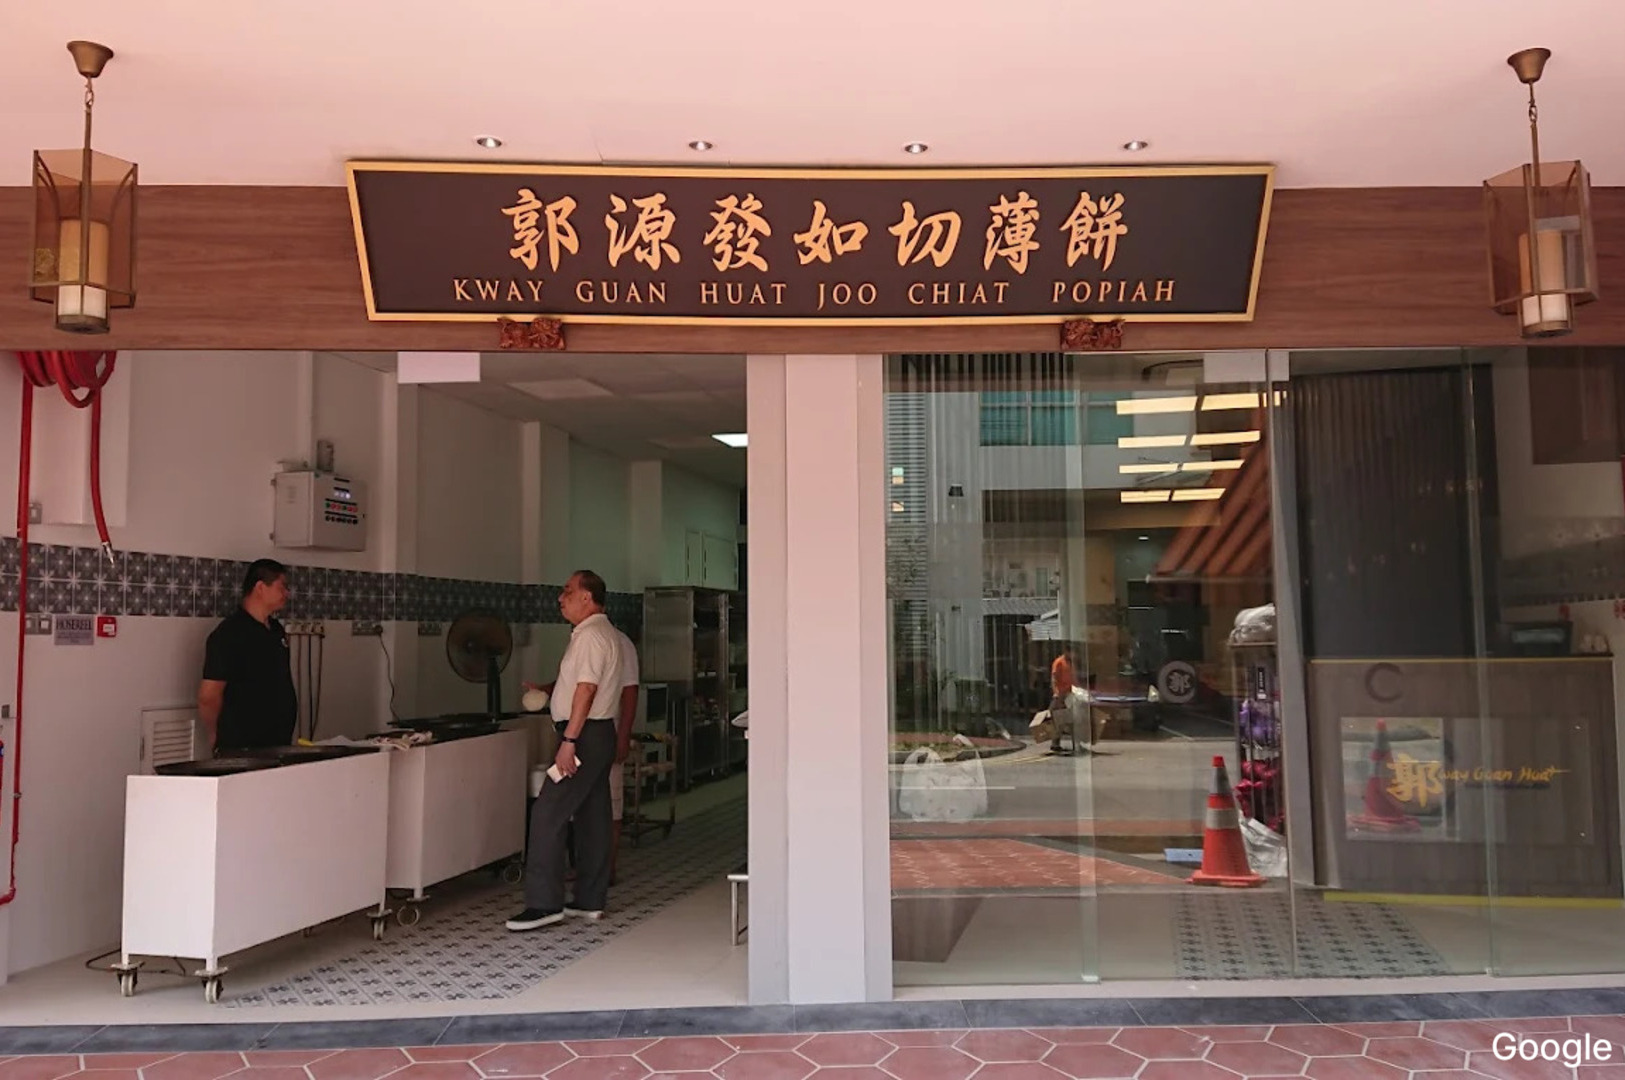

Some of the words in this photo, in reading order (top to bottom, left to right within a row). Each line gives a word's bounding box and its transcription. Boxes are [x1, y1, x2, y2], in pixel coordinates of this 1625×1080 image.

[501, 188, 1128, 275] 郭源發如切薄餅
[453, 279, 543, 302] KWAY
[575, 280, 666, 303] GUAN
[701, 282, 787, 305] HUAT
[816, 283, 877, 310] JOO
[908, 282, 1009, 305] CHIAT
[1053, 280, 1174, 303] POPIAH
